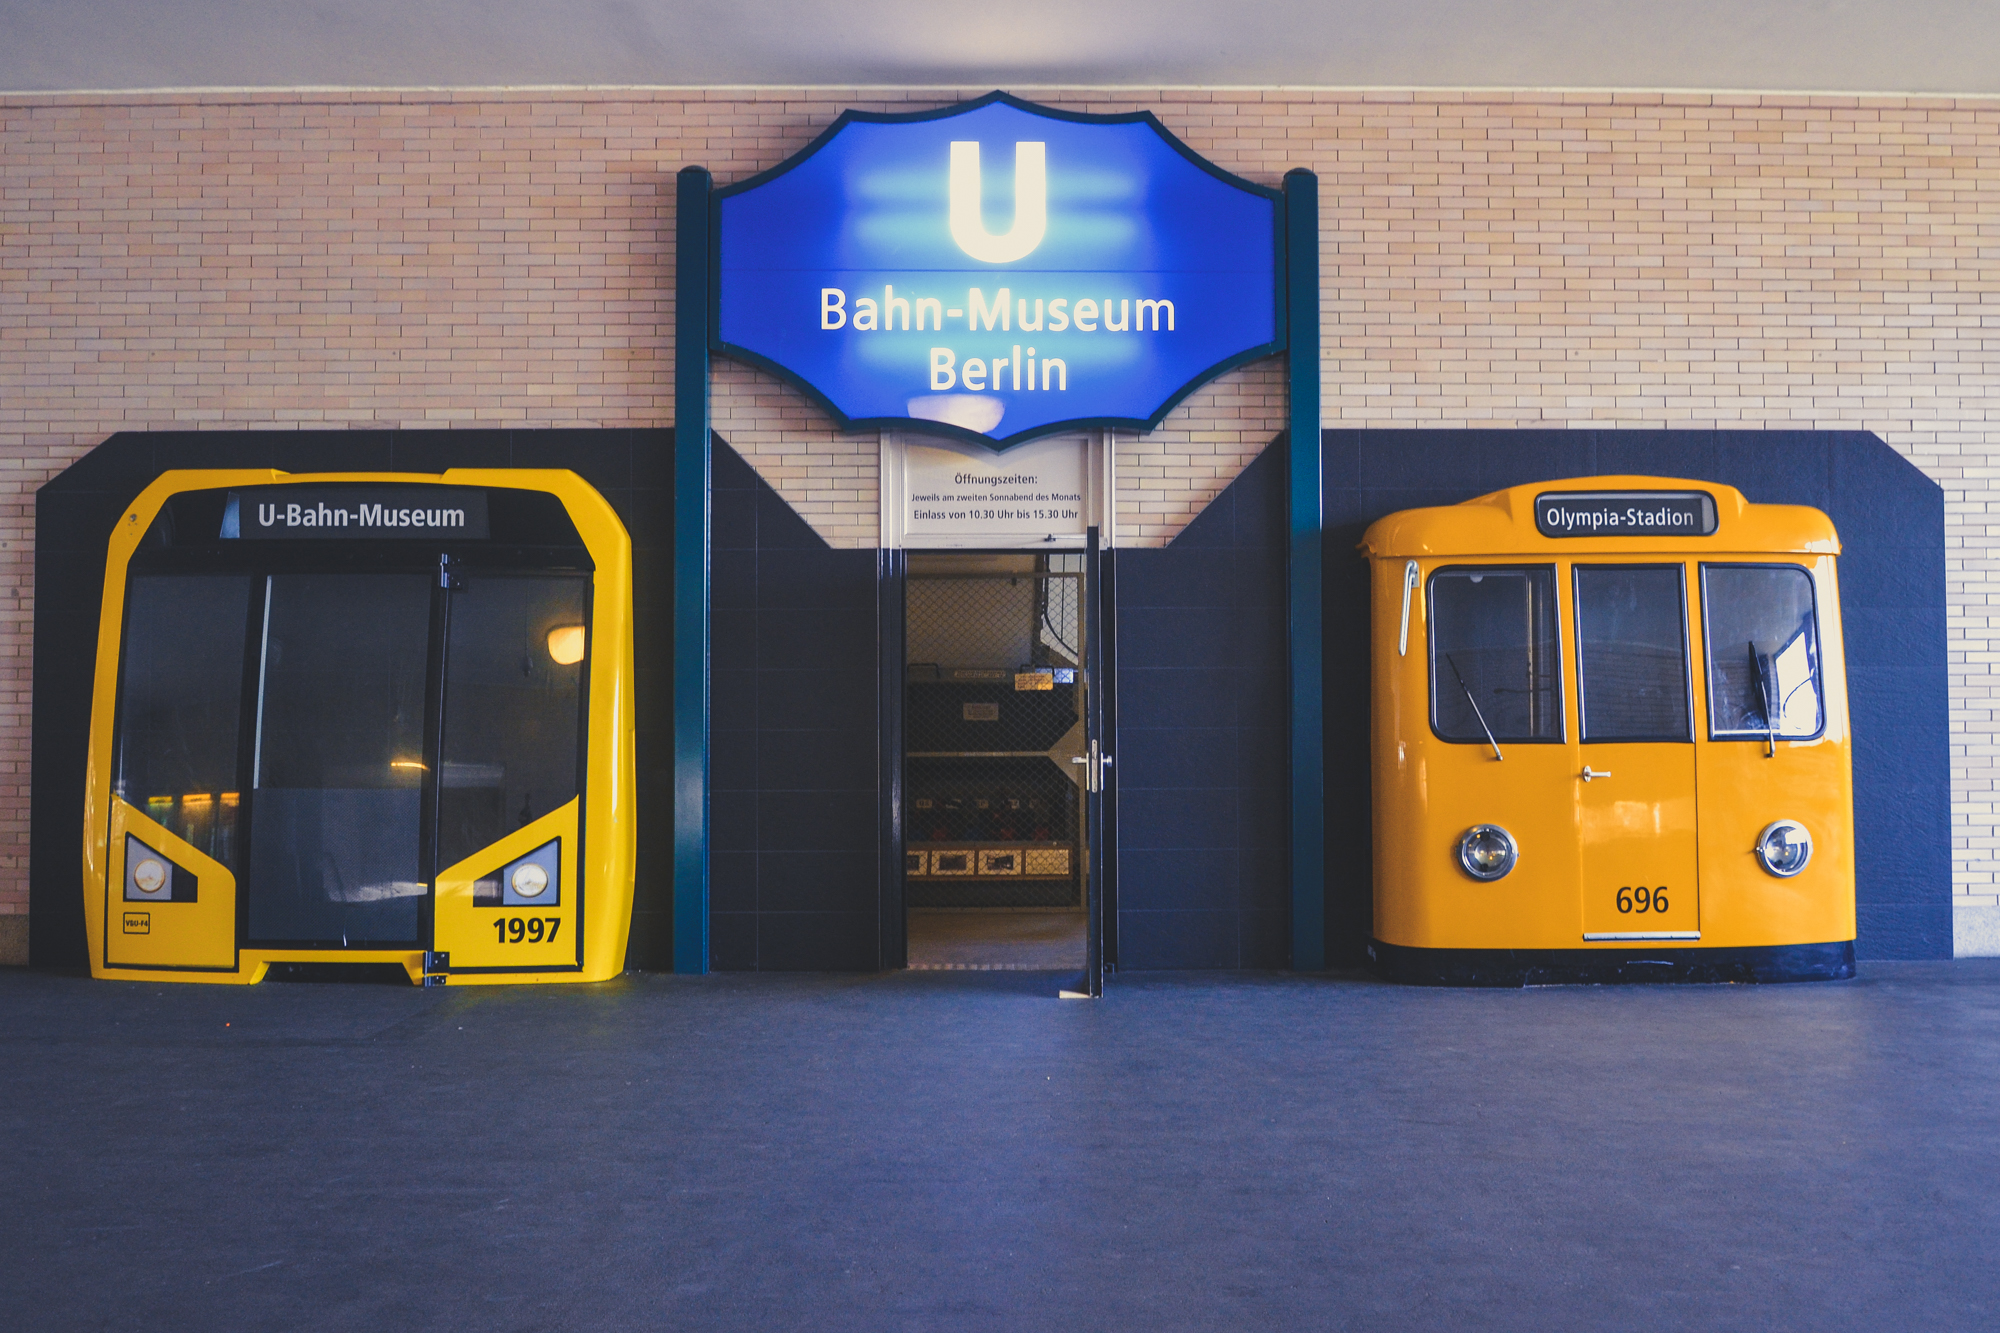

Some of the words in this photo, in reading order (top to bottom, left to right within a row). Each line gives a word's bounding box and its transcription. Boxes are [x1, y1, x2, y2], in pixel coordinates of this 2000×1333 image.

[947, 141, 1048, 264] U
[821, 284, 1176, 332] Bahn-Museum
[929, 344, 1068, 391] Berlin
[954, 472, 1038, 487] Öffnungszeiten:
[911, 493, 940, 502] Jeweils
[956, 493, 988, 502] zweiten
[989, 493, 1034, 502] Sonnabend
[1035, 493, 1050, 502] des
[1051, 493, 1081, 502] Monats
[258, 502, 465, 527] U-Bahn-Museum
[913, 509, 946, 520] Einlass
[948, 511, 966, 520] von
[969, 509, 995, 520] 10.30
[997, 509, 1014, 520] Uhr
[1016, 509, 1031, 519] bis
[1033, 509, 1059, 519] 15.30
[1061, 508, 1079, 519] Uhr
[1546, 506, 1694, 531] Olympia-Stadion
[1615, 886, 1670, 914] 696
[493, 917, 561, 944] 1997
